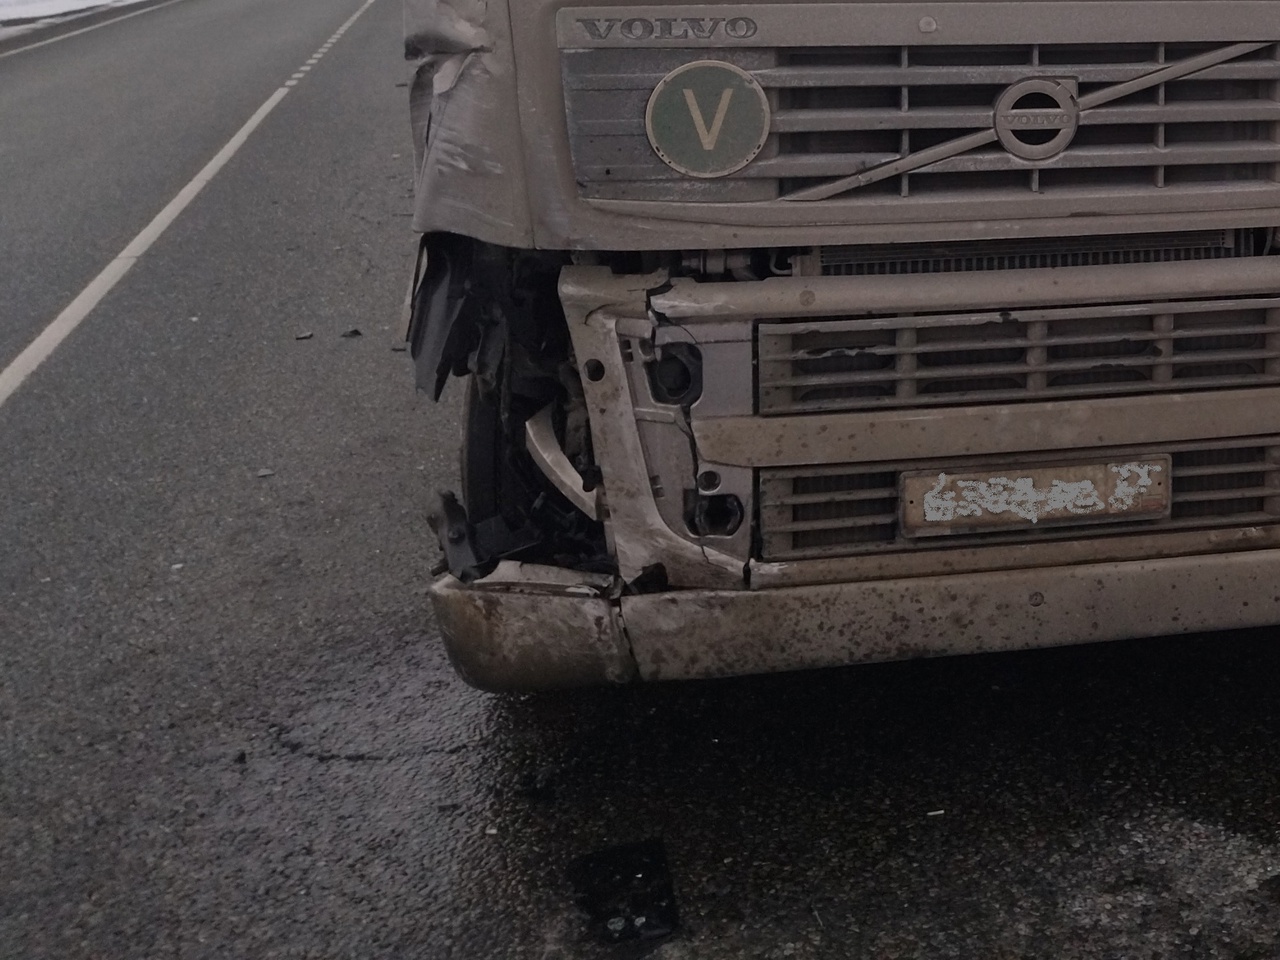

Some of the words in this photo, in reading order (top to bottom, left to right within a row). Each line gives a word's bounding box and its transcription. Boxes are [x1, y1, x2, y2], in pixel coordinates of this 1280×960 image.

[575, 16, 758, 40] VOLVO
[682, 88, 734, 151] V
[1000, 113, 1072, 126] VOLVO
